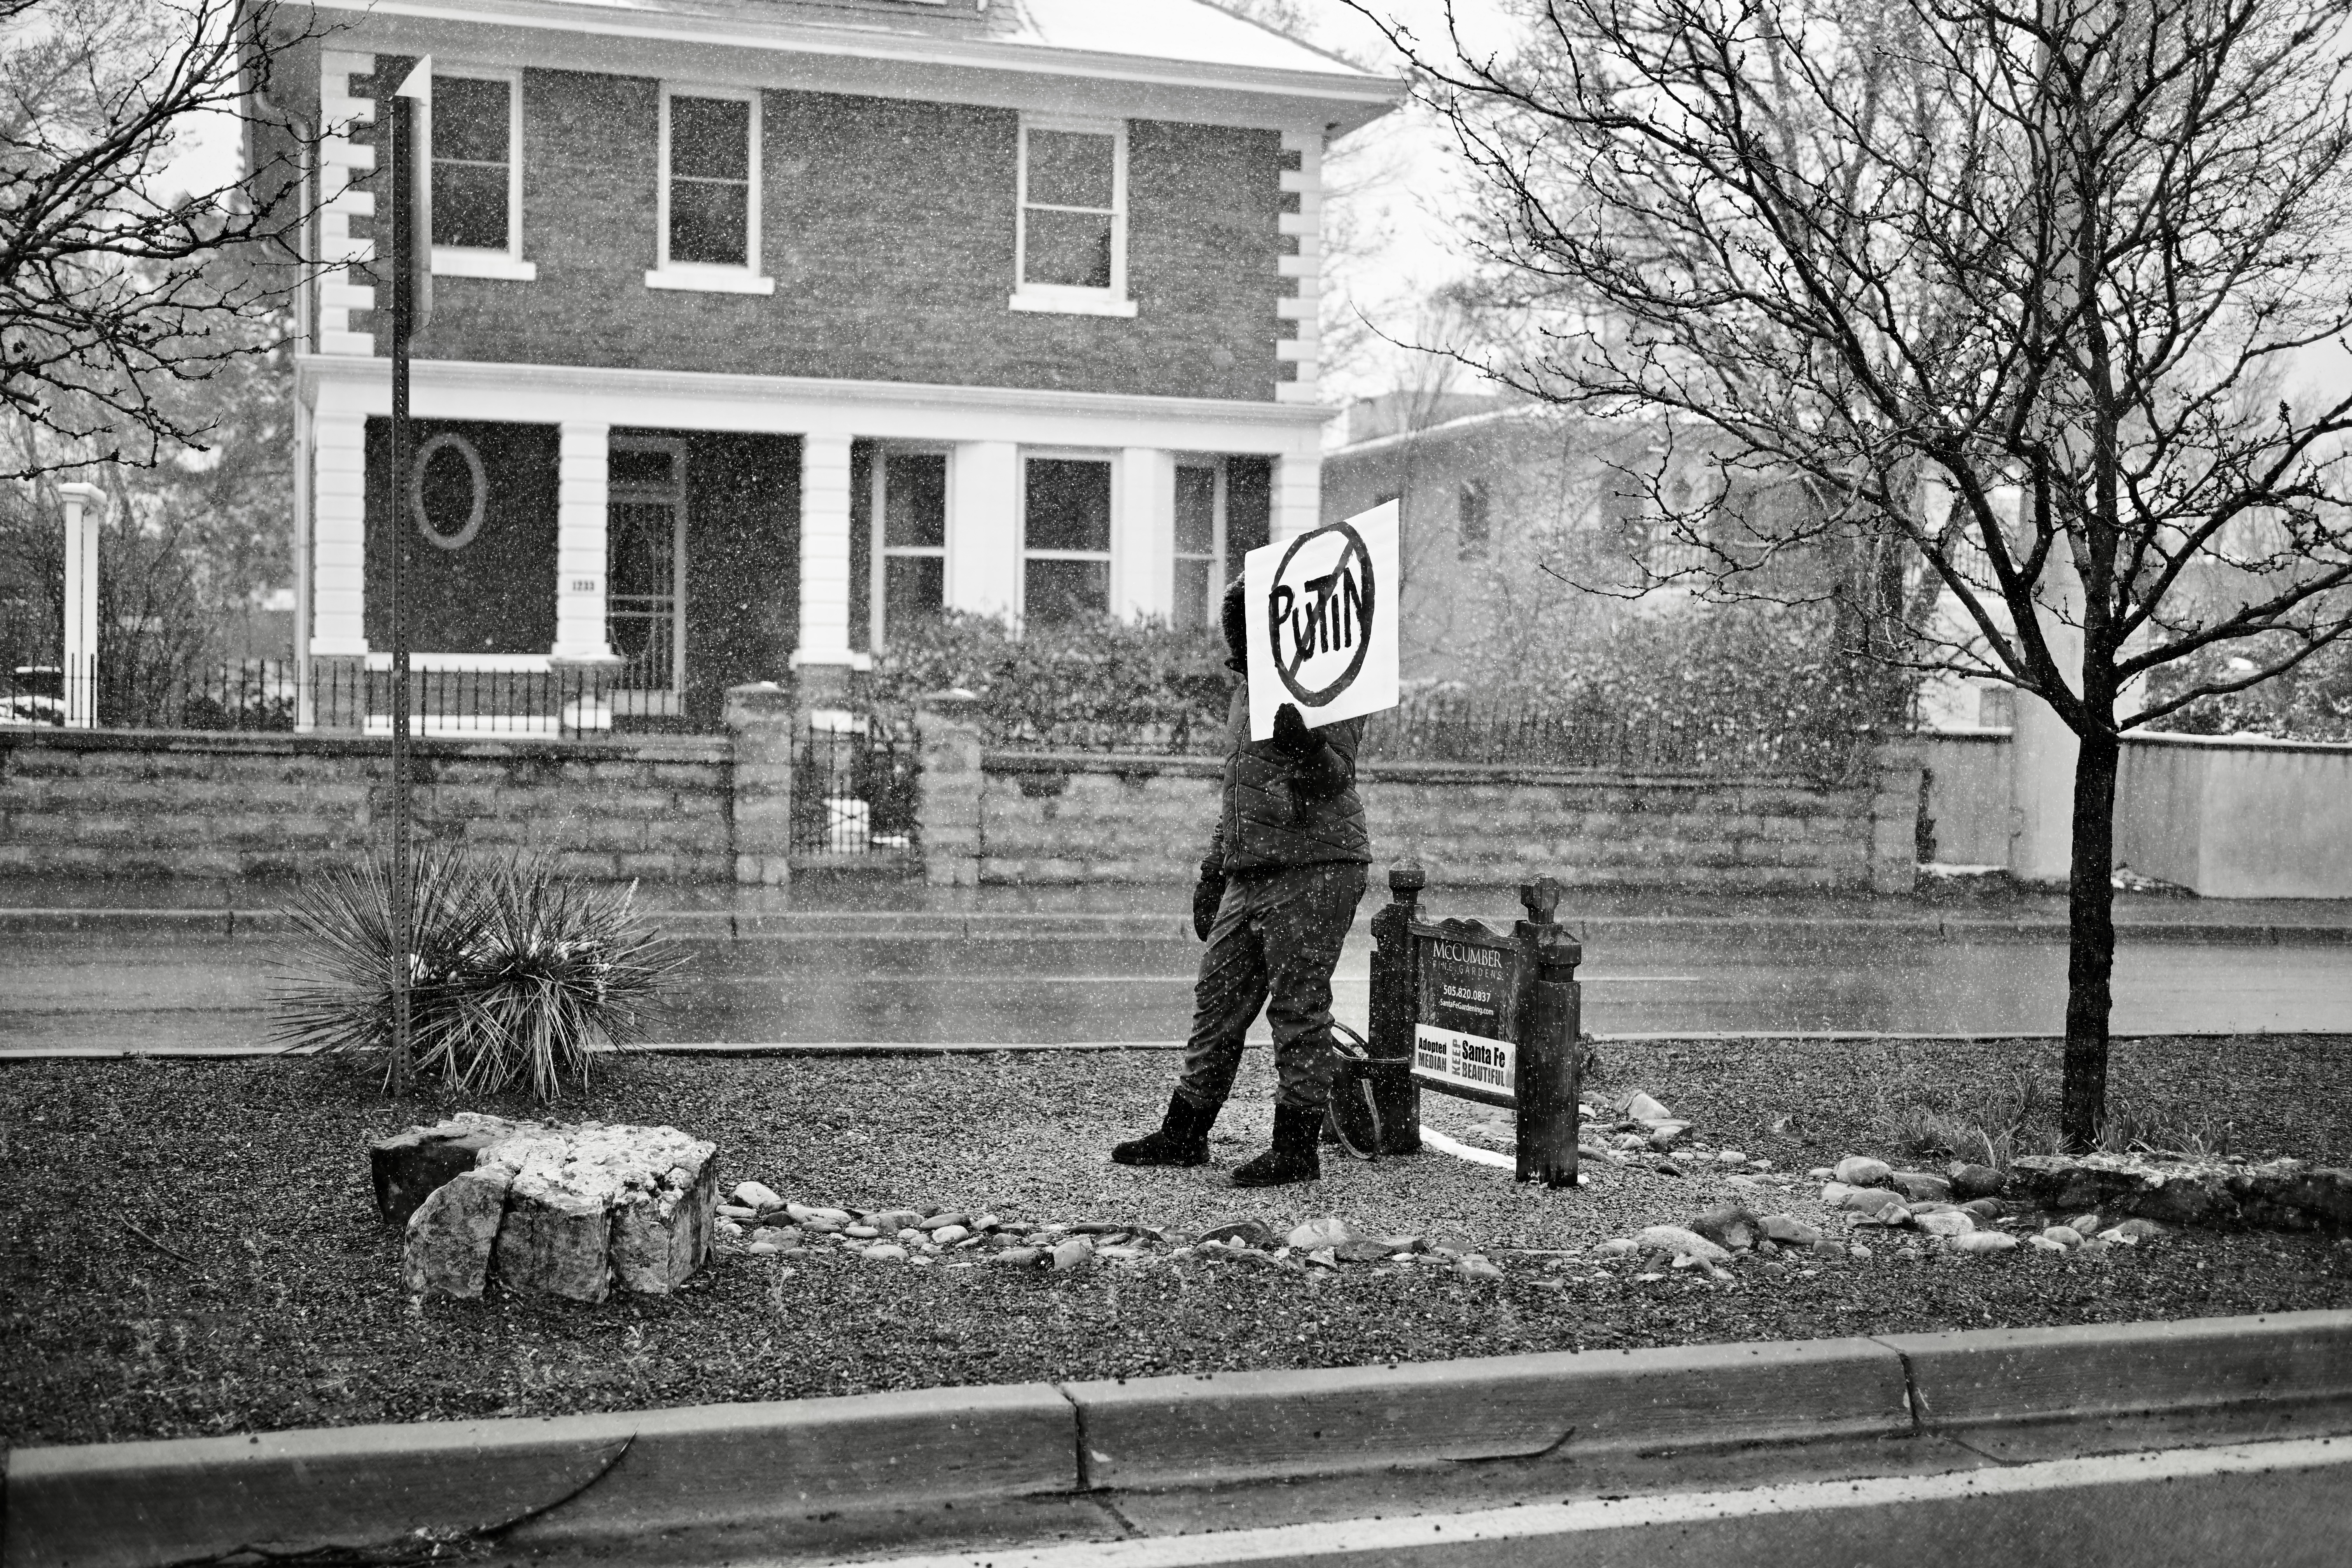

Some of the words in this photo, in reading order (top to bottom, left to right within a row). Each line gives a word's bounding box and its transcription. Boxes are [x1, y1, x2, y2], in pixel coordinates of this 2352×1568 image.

[1433, 960, 1452, 971] FINE
[1459, 964, 1502, 980] GARDENS
[1443, 985, 1491, 1003] 505.820.0837
[1440, 998, 1494, 1016] SantaFeGardening.com
[1418, 1037, 1447, 1055] Adopted
[1462, 1040, 1491, 1065] Santa
[1494, 1047, 1505, 1068] Fe
[1418, 1052, 1447, 1072] MEDIAN
[1452, 1039, 1461, 1076] KEEP
[1462, 1062, 1505, 1087] BEAUTIFUL
